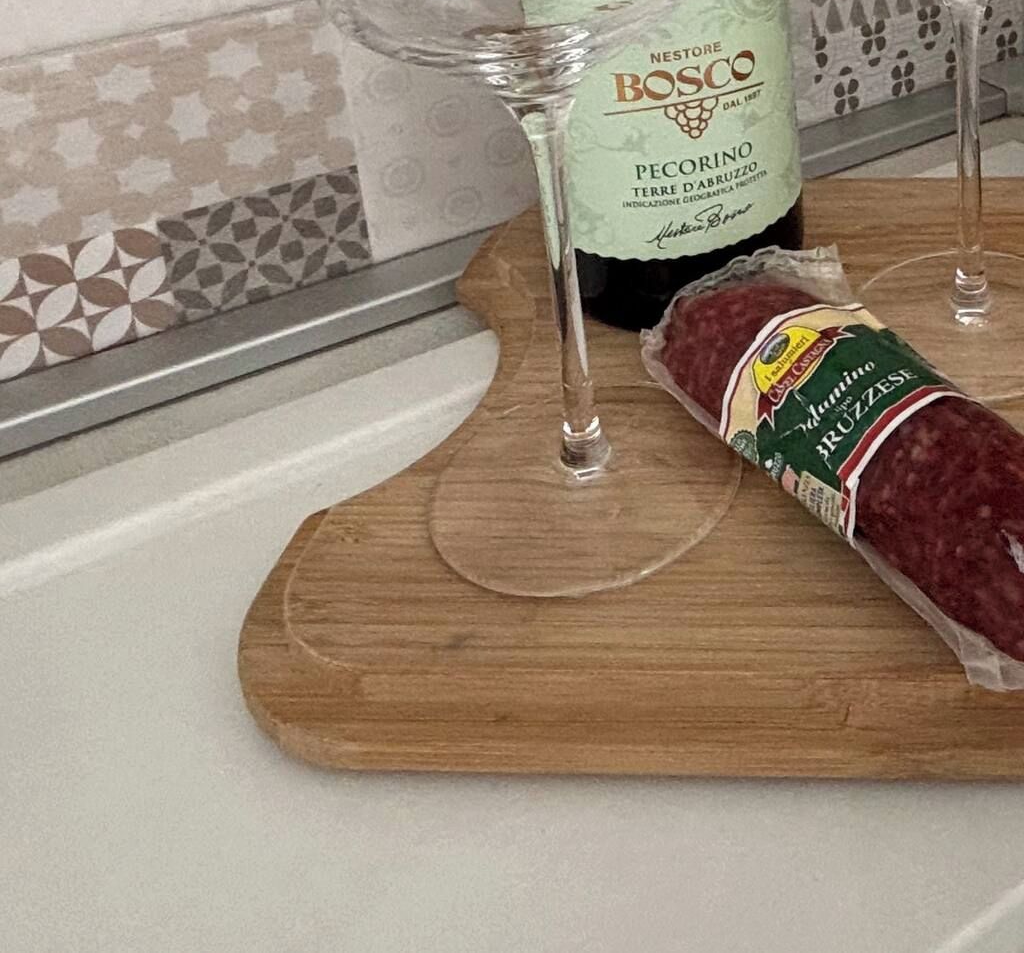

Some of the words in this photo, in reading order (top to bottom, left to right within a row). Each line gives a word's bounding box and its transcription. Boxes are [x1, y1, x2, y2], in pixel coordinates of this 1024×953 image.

[650, 41, 722, 64] NESTORE
[610, 50, 755, 103] BOSCO
[723, 98, 743, 111] DAL
[635, 141, 752, 180] PECORINO
[622, 198, 680, 208] INDICAZIONE
[682, 185, 734, 204] GEOGRAFICA
[631, 185, 678, 198] TERRE
[683, 161, 758, 193] D'ABRUZZO
[771, 334, 809, 378] salumieri
